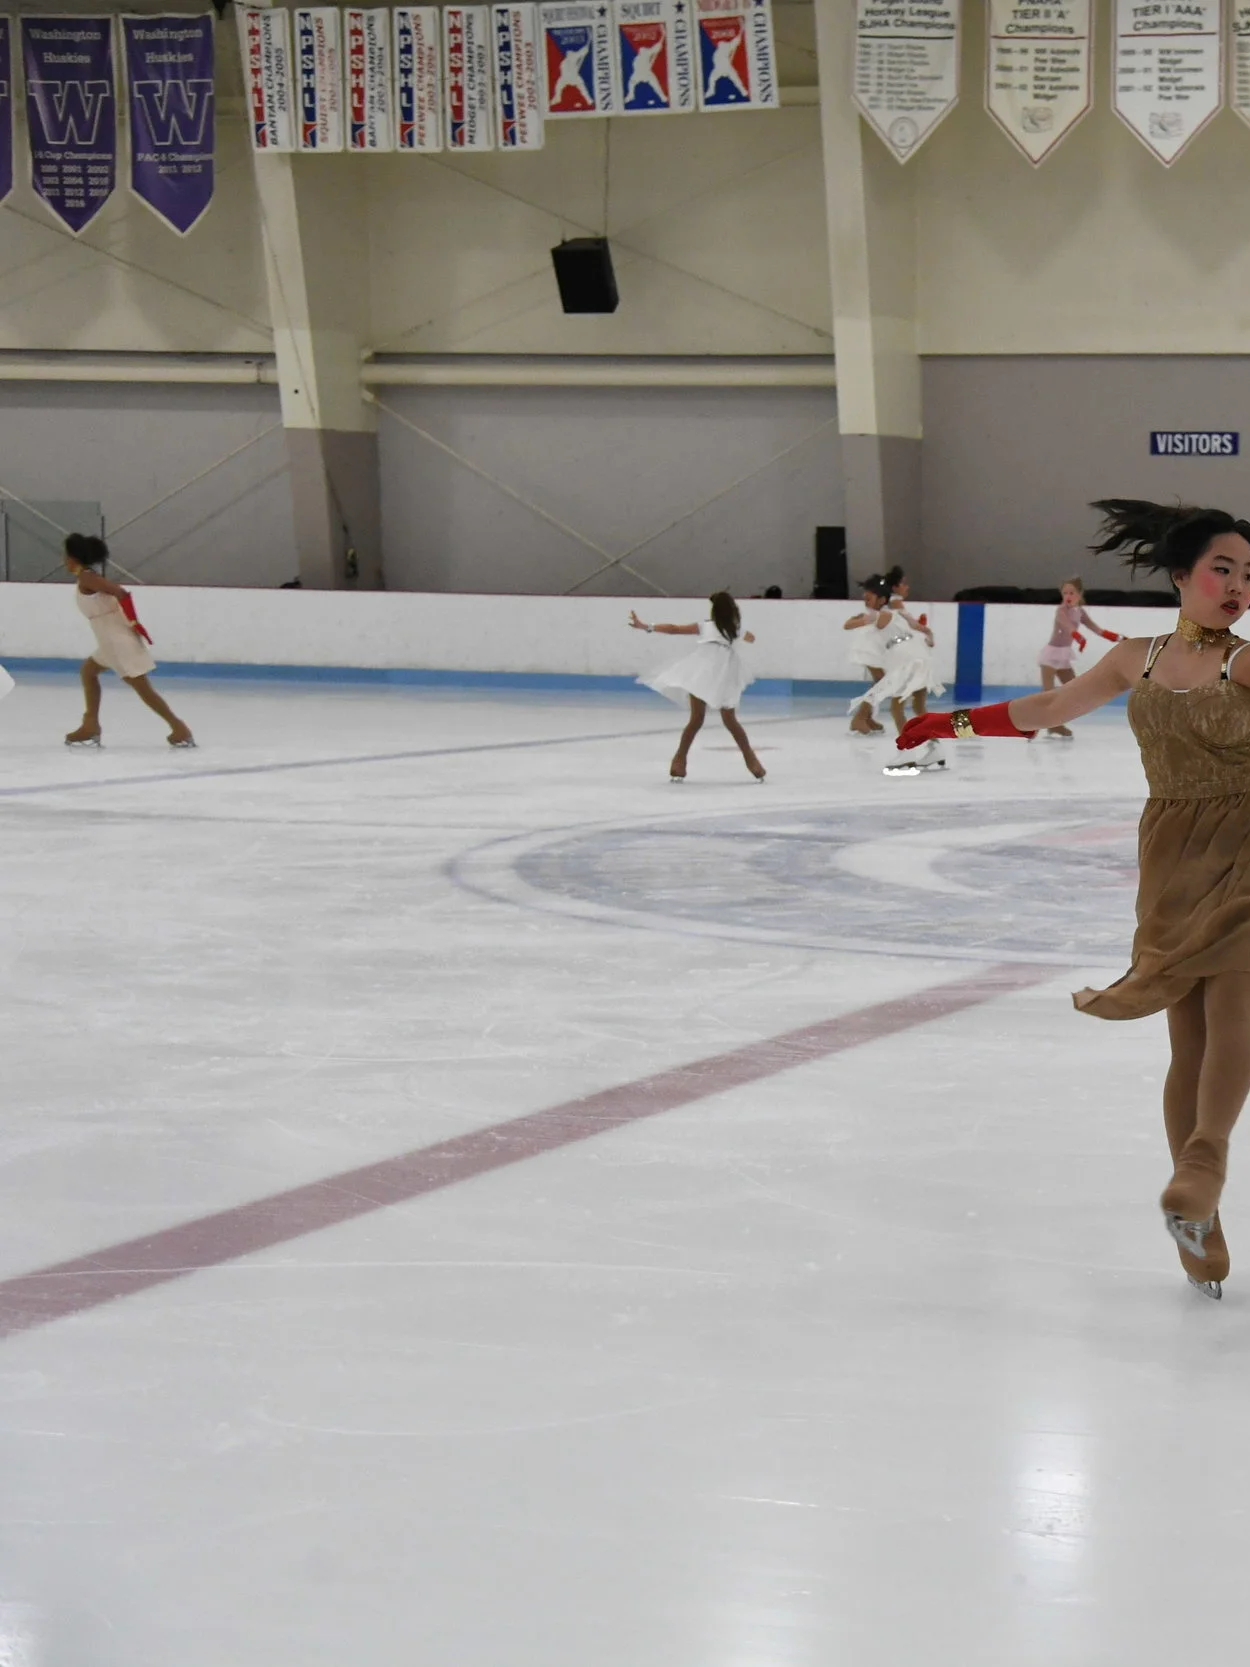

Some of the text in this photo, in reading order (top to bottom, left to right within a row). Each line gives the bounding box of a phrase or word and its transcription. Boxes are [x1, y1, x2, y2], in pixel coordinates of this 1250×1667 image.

[909, 7, 950, 19] League
[1012, 8, 1040, 19] TIER
[1132, 5, 1161, 18] TIER
[29, 28, 102, 41] Washington
[133, 28, 203, 41] Washington
[893, 18, 955, 30] Champions
[1005, 24, 1074, 35] Champions
[1133, 20, 1204, 31] Champions
[43, 52, 92, 63] Huskies
[145, 52, 194, 63] Huskies
[365, 15, 376, 91] CHAMPIONS
[412, 13, 425, 91] CHAMPIONS
[512, 10, 524, 89] CHAMPIONS
[753, 11, 774, 103] CHAMPIONS
[597, 23, 612, 111] CHAMPIONS
[674, 18, 692, 108] CHAMPIONS
[262, 14, 278, 146] BANTAM CHAMPIONS
[465, 13, 477, 145] MIDGET CHAMPIONS
[28, 80, 109, 145] W
[134, 79, 214, 145] W
[1156, 433, 1233, 454] VISITORS
